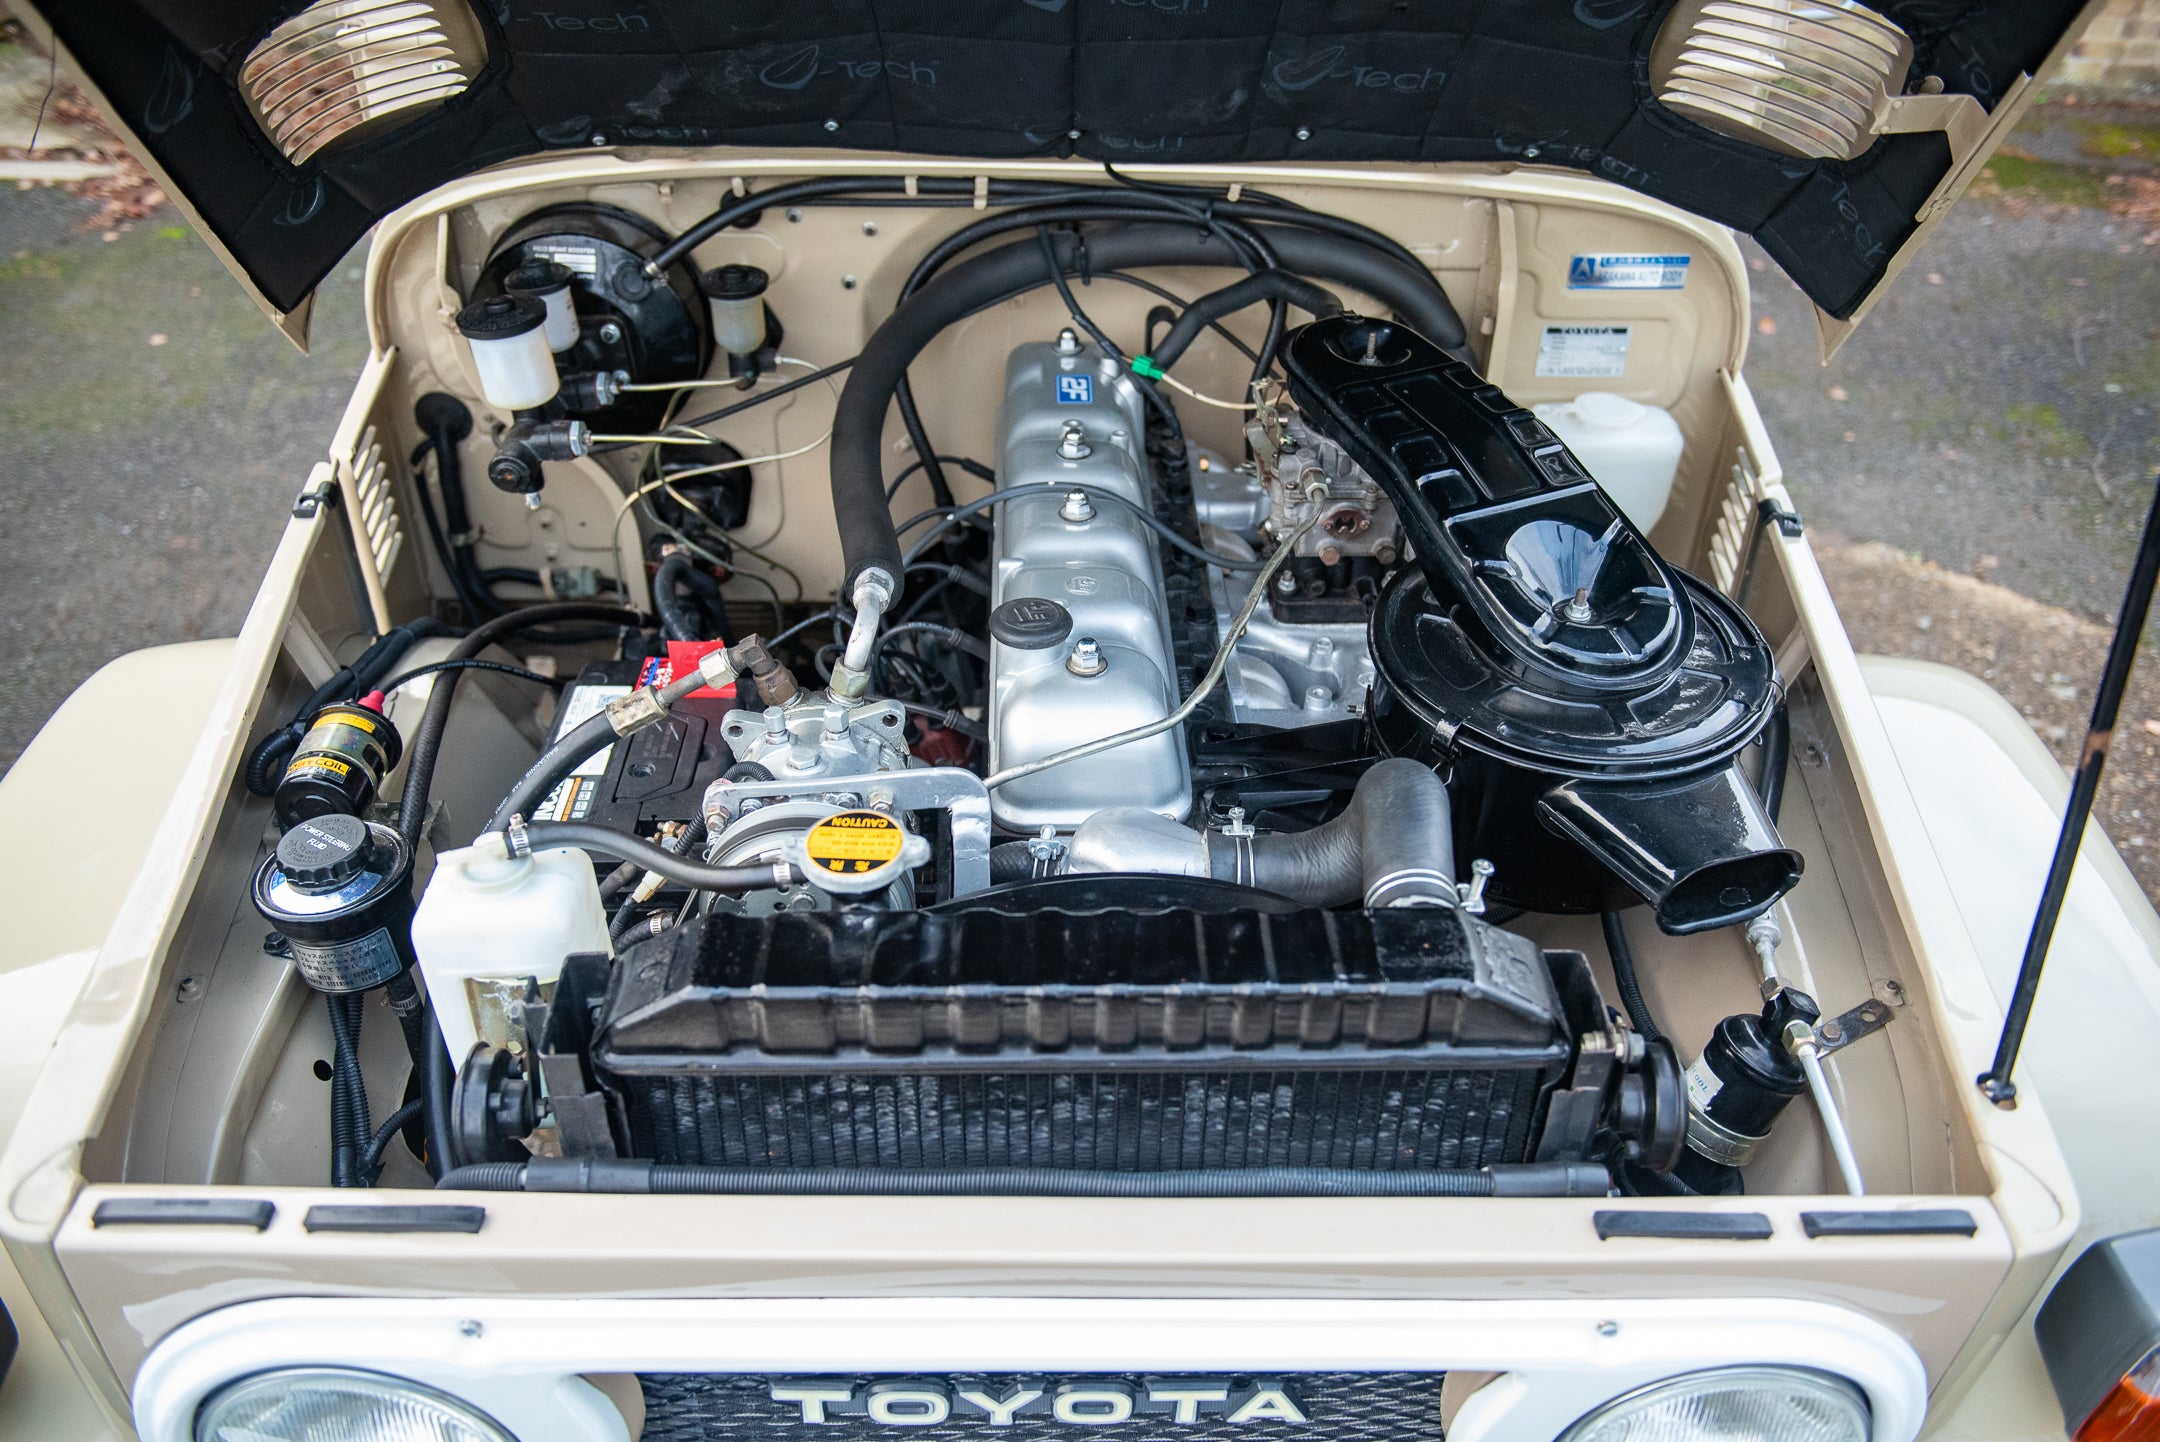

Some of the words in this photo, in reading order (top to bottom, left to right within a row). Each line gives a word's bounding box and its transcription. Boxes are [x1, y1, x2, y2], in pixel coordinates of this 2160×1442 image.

[831, 817, 888, 828] CAUTION
[301, 823, 324, 838] POWER
[322, 834, 353, 852] STEERING
[307, 838, 328, 850] FLUID
[771, 1388, 1307, 1427] TOYOTA
